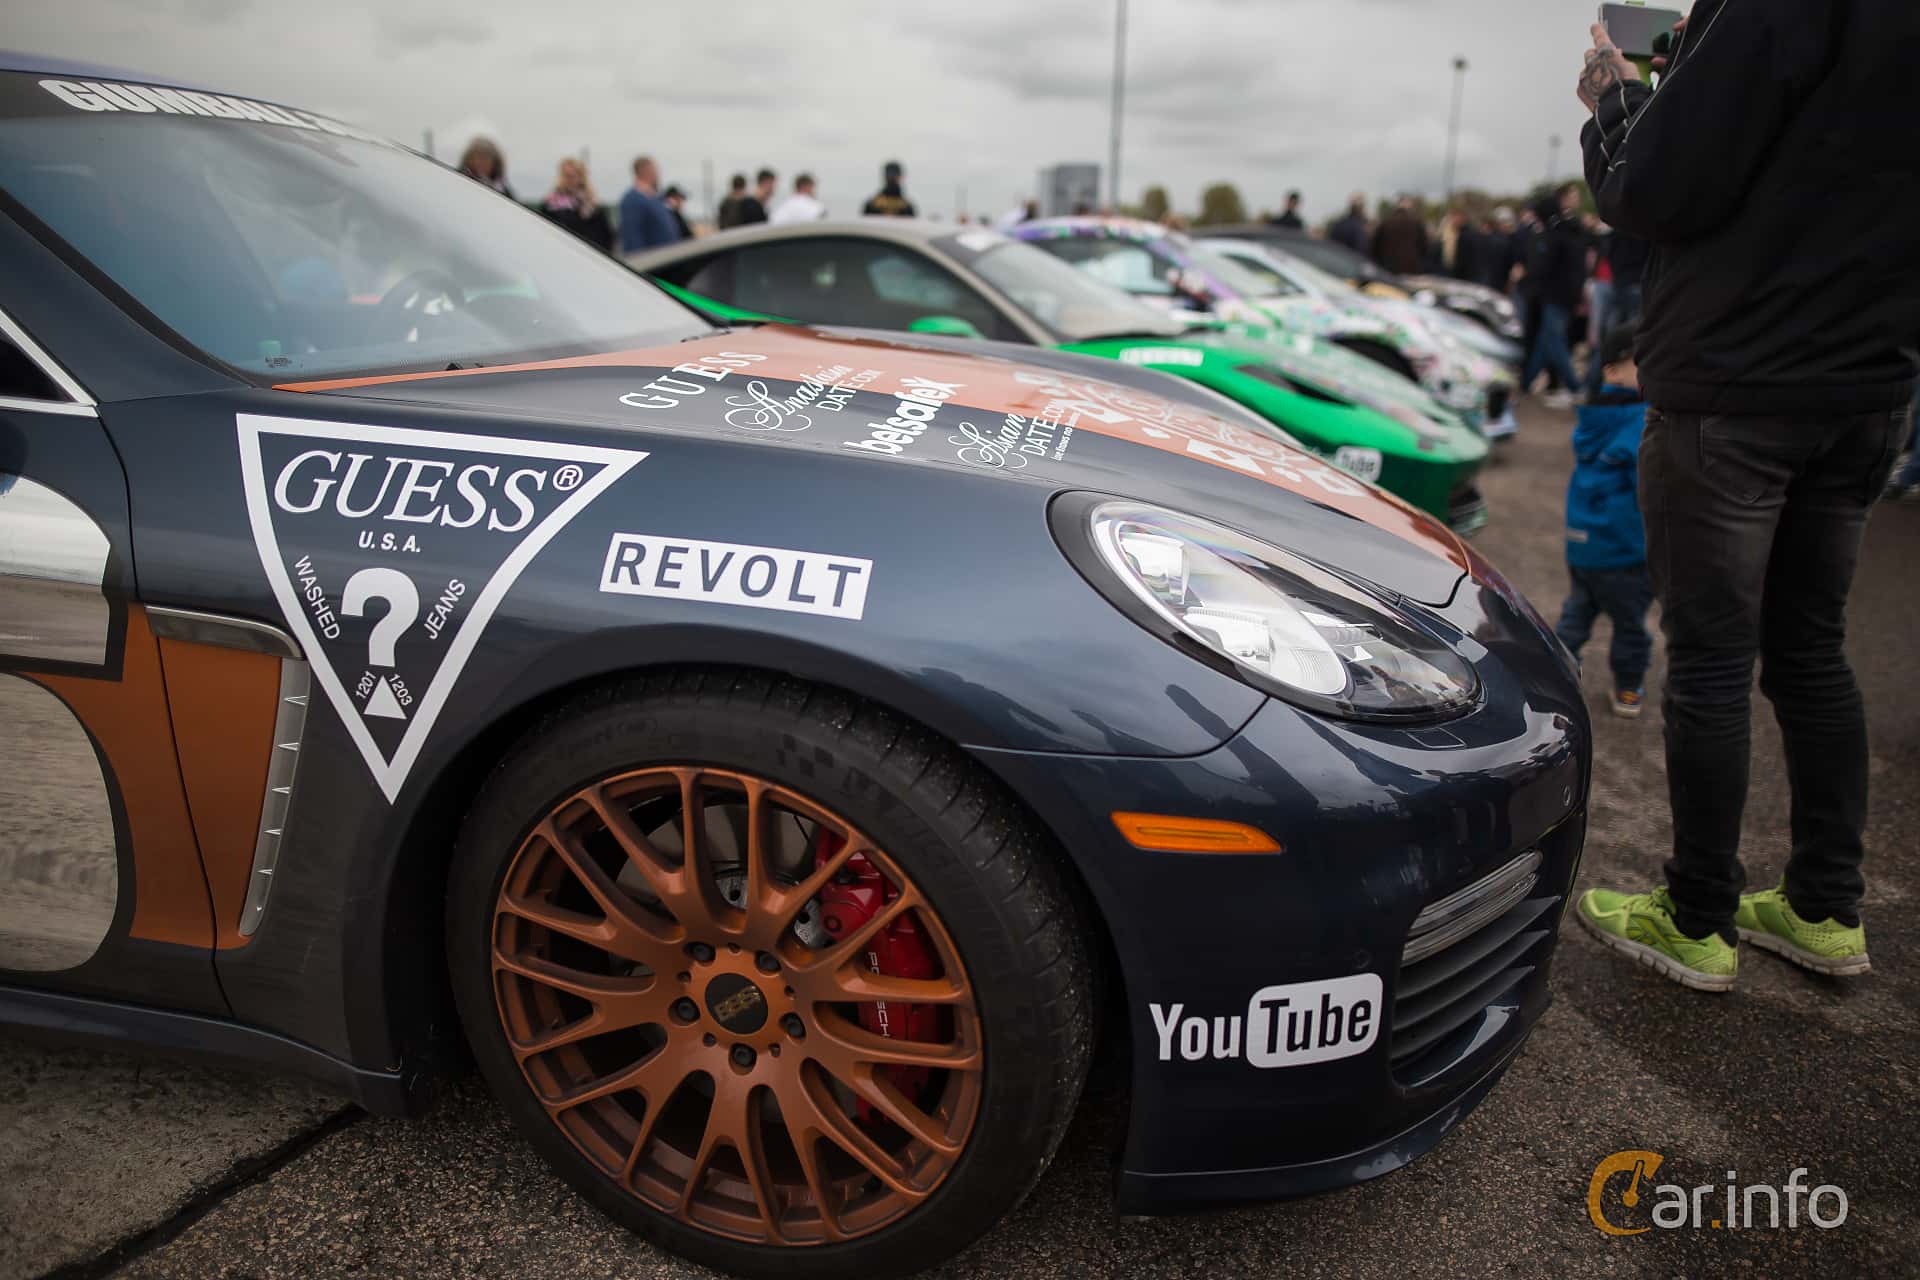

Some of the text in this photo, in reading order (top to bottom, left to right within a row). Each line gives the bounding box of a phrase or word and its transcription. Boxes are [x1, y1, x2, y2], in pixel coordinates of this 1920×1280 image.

[618, 352, 768, 409] GUESS
[295, 556, 340, 640] WASHED
[609, 541, 862, 608] REVOLT
[423, 578, 467, 640] JEANS
[356, 671, 377, 699] 1201
[389, 674, 413, 706] 1203
